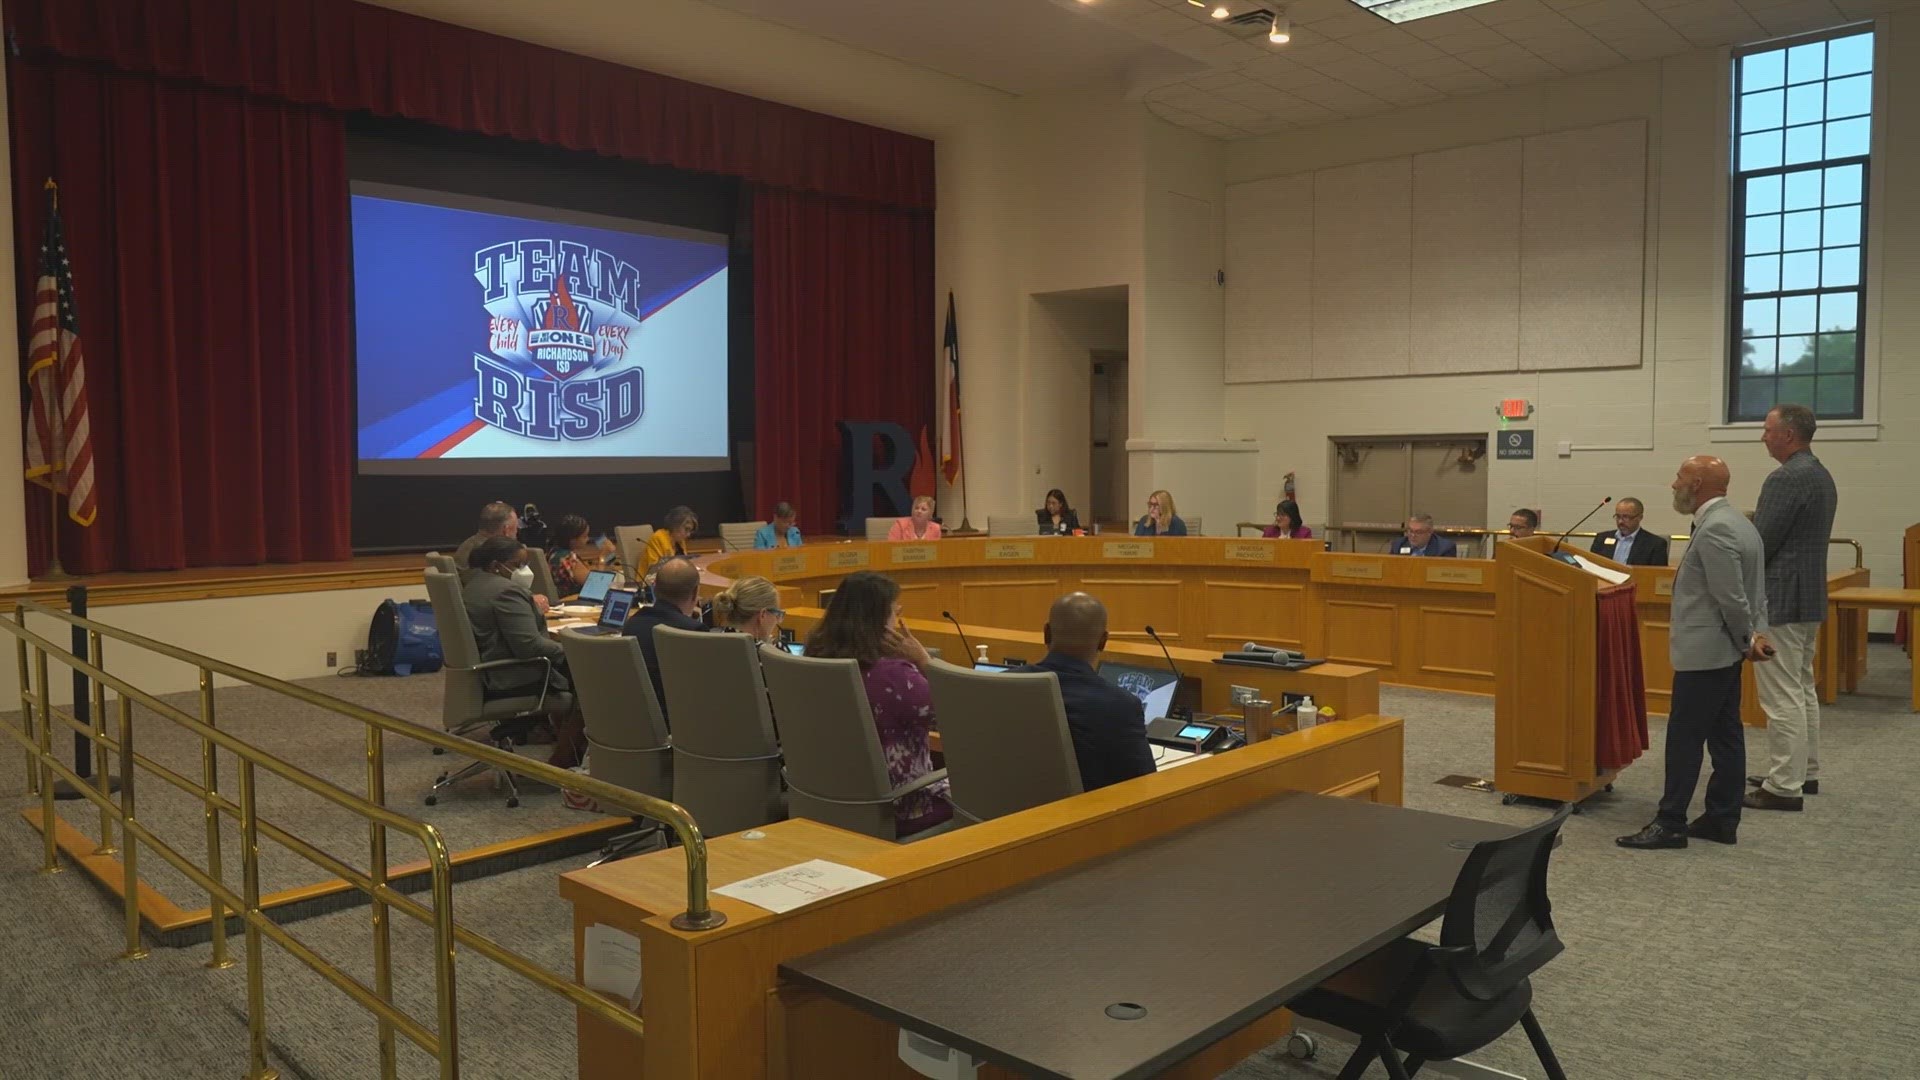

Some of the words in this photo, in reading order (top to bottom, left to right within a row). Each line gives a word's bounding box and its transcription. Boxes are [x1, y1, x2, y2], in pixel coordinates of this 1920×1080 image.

[474, 239, 642, 322] TEAM
[489, 315, 520, 335] EVERY
[489, 333, 519, 352] Child
[549, 331, 585, 346] ONE
[598, 325, 630, 349] EVERY
[537, 346, 589, 362] RICHARDSON
[602, 340, 624, 361] Day
[556, 360, 571, 374] ISD
[474, 353, 645, 441] RISD
